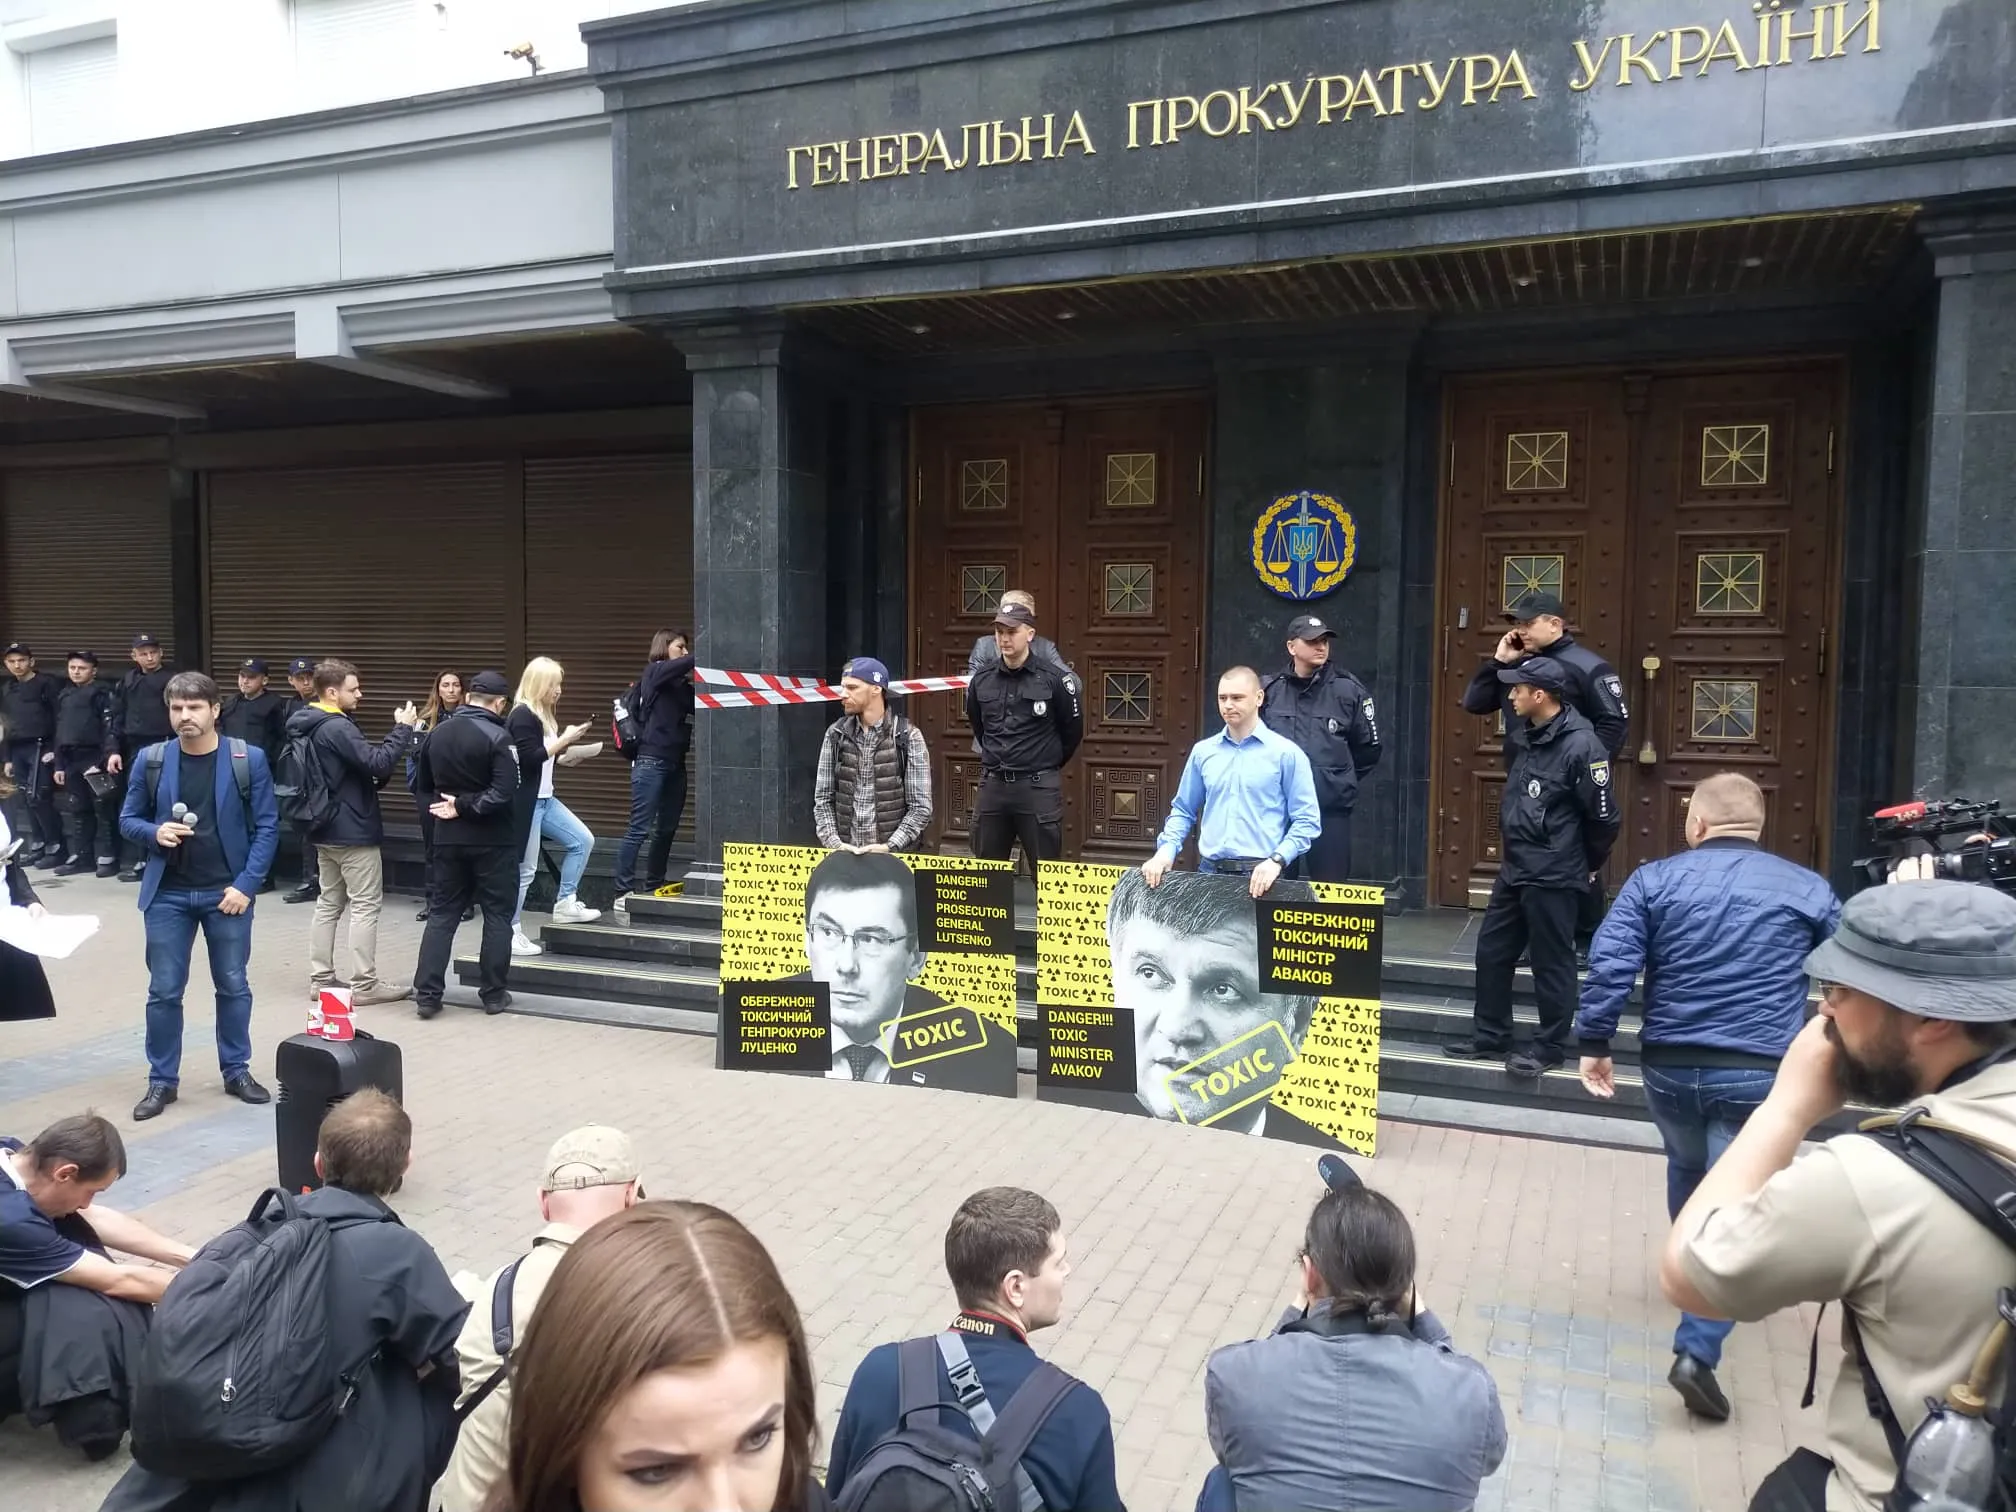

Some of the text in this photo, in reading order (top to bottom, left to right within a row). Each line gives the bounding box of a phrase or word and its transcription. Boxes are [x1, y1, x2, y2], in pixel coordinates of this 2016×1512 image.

[785, 0, 1882, 190] ГЕНЕРАЛЬНА ПРОКУРАТУРА УКРАЇНИ
[724, 846, 803, 858] TOXIC TOXIC
[755, 863, 786, 873] TOXIC
[924, 858, 956, 869] TOXIC
[1037, 863, 1071, 874] TOXIC
[733, 880, 764, 889] TOXIC
[936, 874, 988, 888] DANGER!!!
[936, 888, 967, 900] TOXIC
[1072, 884, 1107, 895] TOXIC
[1335, 887, 1377, 900] TOXIC
[724, 894, 804, 907] TOXIC TOXIC
[1048, 900, 1082, 911] TOXIC
[759, 911, 790, 922] TOXIC
[936, 903, 1007, 919] PROSECUTOR
[936, 917, 984, 931] GENERAL
[1038, 916, 1072, 927] TOXIC
[1273, 910, 1375, 932] ОБЕРЕЖНО!!!
[722, 929, 803, 942] TOXIC TOXIC
[936, 932, 992, 947] LUTSENKO
[1272, 928, 1368, 951] ТОКСИЧНИЙ
[747, 946, 778, 956] TOXIC
[1272, 947, 1336, 965] МІНІСТР
[1037, 953, 1070, 964] TOXIC
[728, 960, 760, 971] TOXIC
[951, 963, 984, 975] TOXIC
[933, 975, 965, 987] TOXIC
[1065, 972, 1099, 983] TOXIC
[1272, 966, 1332, 985] АВАКОВ
[962, 993, 996, 1004] TOXIC
[1044, 987, 1079, 999] TOXIC
[740, 995, 815, 1008] ОБЕРЕЖНО!!!
[740, 1009, 812, 1023] ТОКСИЧНИЙ
[1048, 1010, 1114, 1026] DANGER!!!
[740, 1026, 826, 1038] ГЕНПРОКУРОР
[900, 1018, 967, 1050] TOXIC
[1049, 1028, 1088, 1042] TOXIC
[1313, 1034, 1353, 1049] TOXIC
[740, 1042, 797, 1055] ЛУЦЕНКО
[1050, 1046, 1114, 1062] MINISTER
[1300, 1053, 1340, 1068] TOXIC
[1050, 1064, 1103, 1079] AVAKOV
[1189, 1048, 1275, 1104] TOXIC
[1297, 1095, 1337, 1112] TOXIC
